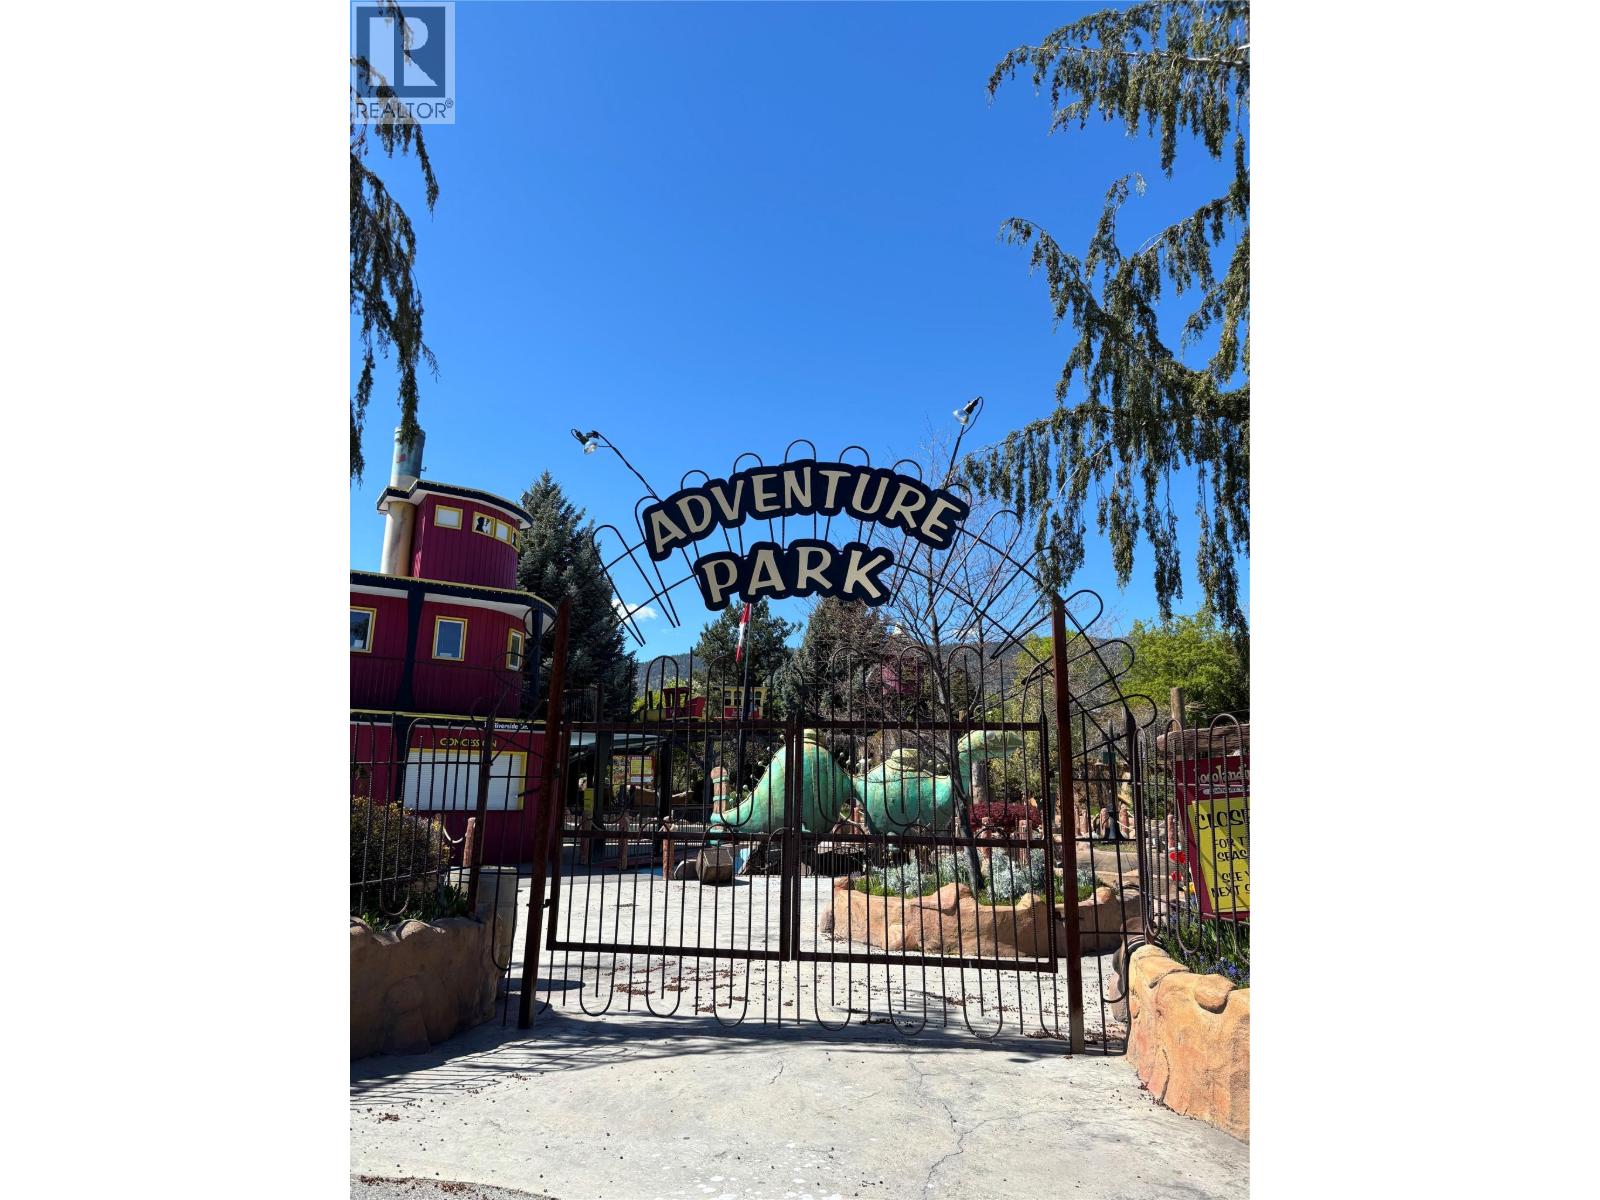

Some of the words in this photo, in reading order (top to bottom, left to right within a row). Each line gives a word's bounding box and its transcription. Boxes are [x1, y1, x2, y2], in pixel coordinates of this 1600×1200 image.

[650, 466, 962, 554] ADVENTURE
[701, 545, 887, 603] PARK
[439, 737, 498, 748] CONCESSIN
[1211, 885, 1241, 898] NEXT
